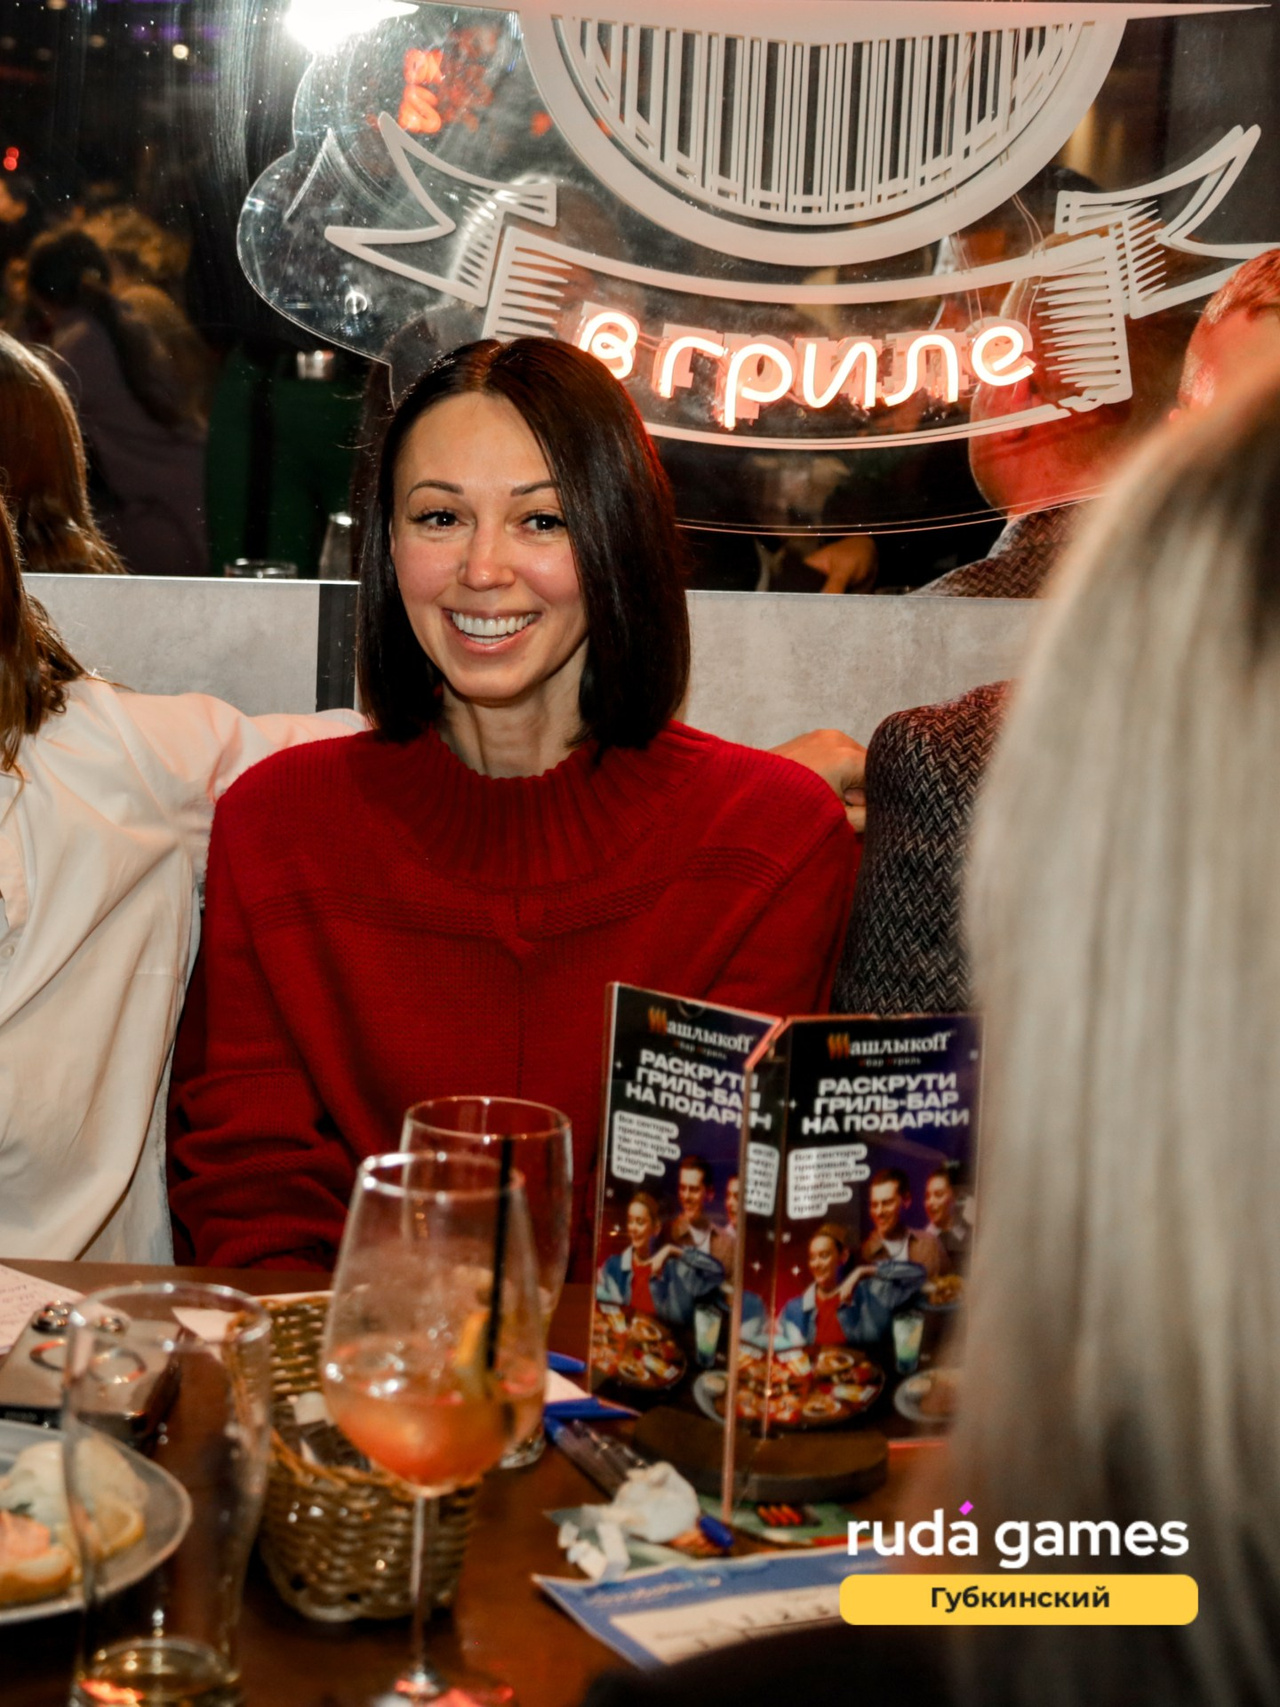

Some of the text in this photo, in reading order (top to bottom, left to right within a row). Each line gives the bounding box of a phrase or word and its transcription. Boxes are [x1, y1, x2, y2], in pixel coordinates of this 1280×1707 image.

[578, 309, 1036, 430] в гриле
[625, 1081, 657, 1106] НА
[818, 1072, 957, 1097] РАСКРУТИ
[814, 1090, 960, 1115] ГРИЛЬ-БАР
[801, 1108, 970, 1136] НА ПОДАРКИ
